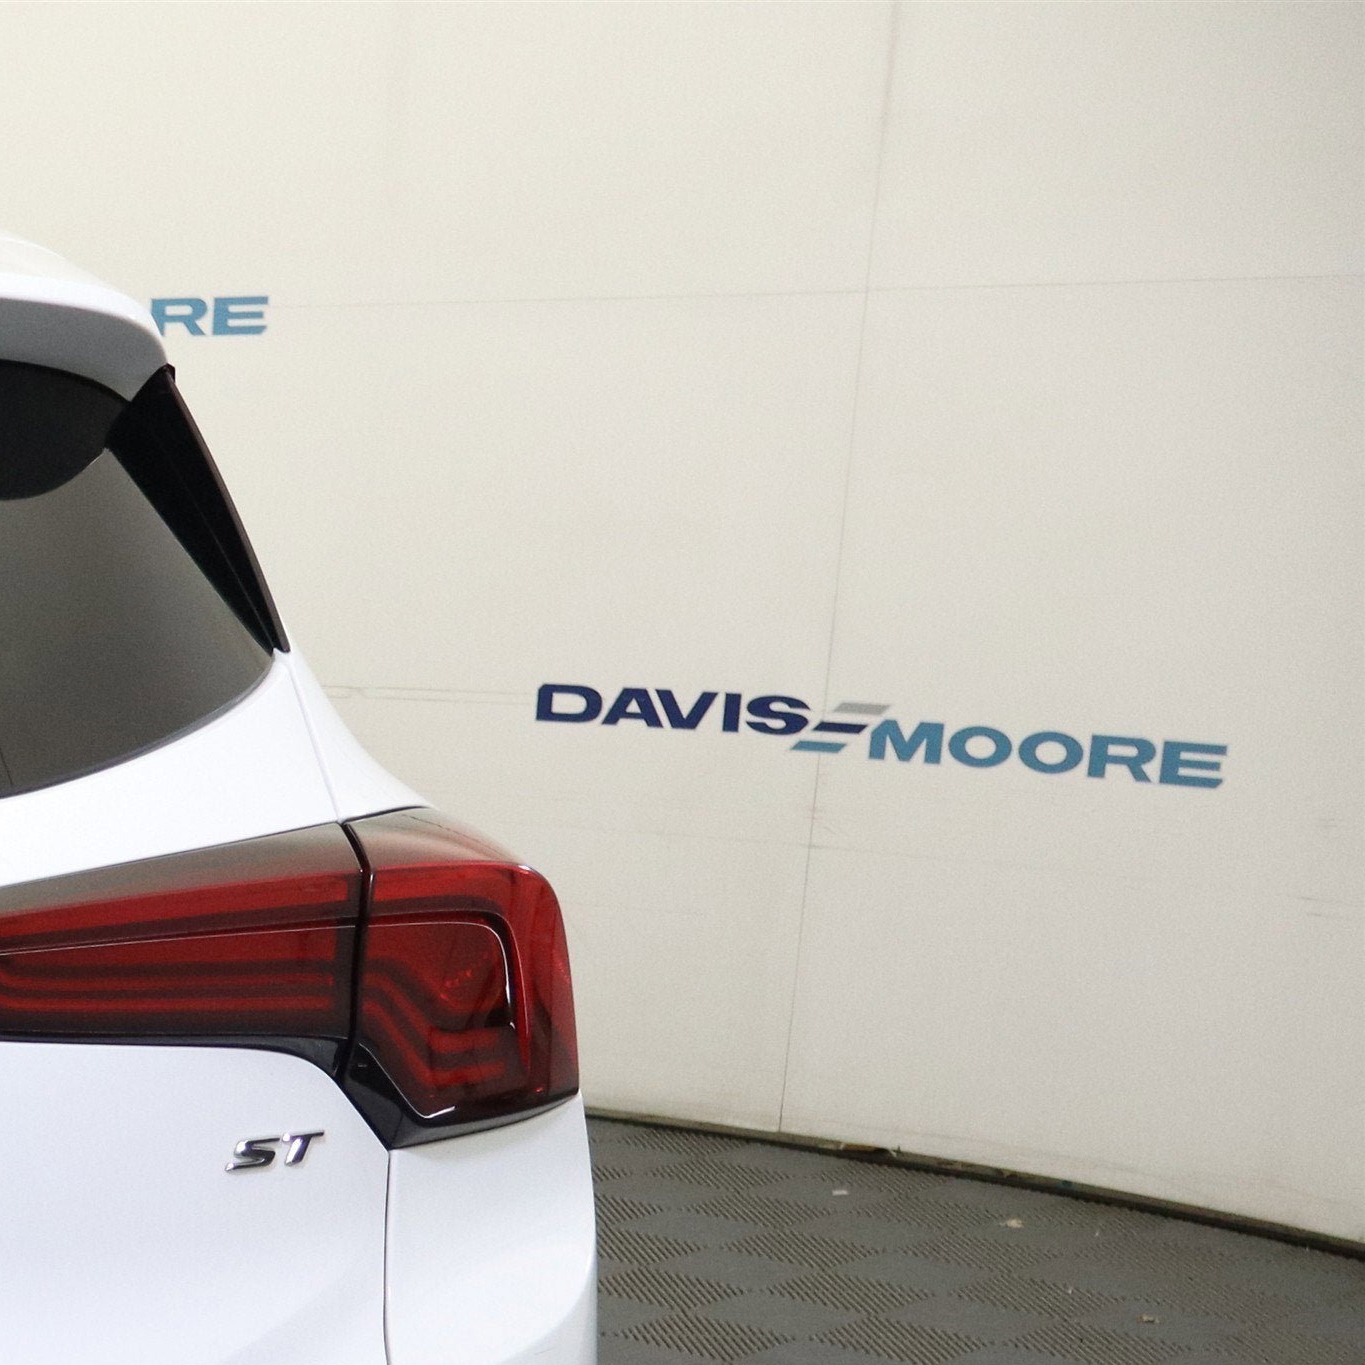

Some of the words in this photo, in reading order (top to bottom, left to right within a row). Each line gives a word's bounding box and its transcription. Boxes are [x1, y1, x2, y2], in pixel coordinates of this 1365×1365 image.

[535, 683, 810, 736] DAVIS
[869, 719, 1228, 788] MOORE
[225, 1129, 325, 1172] ST
